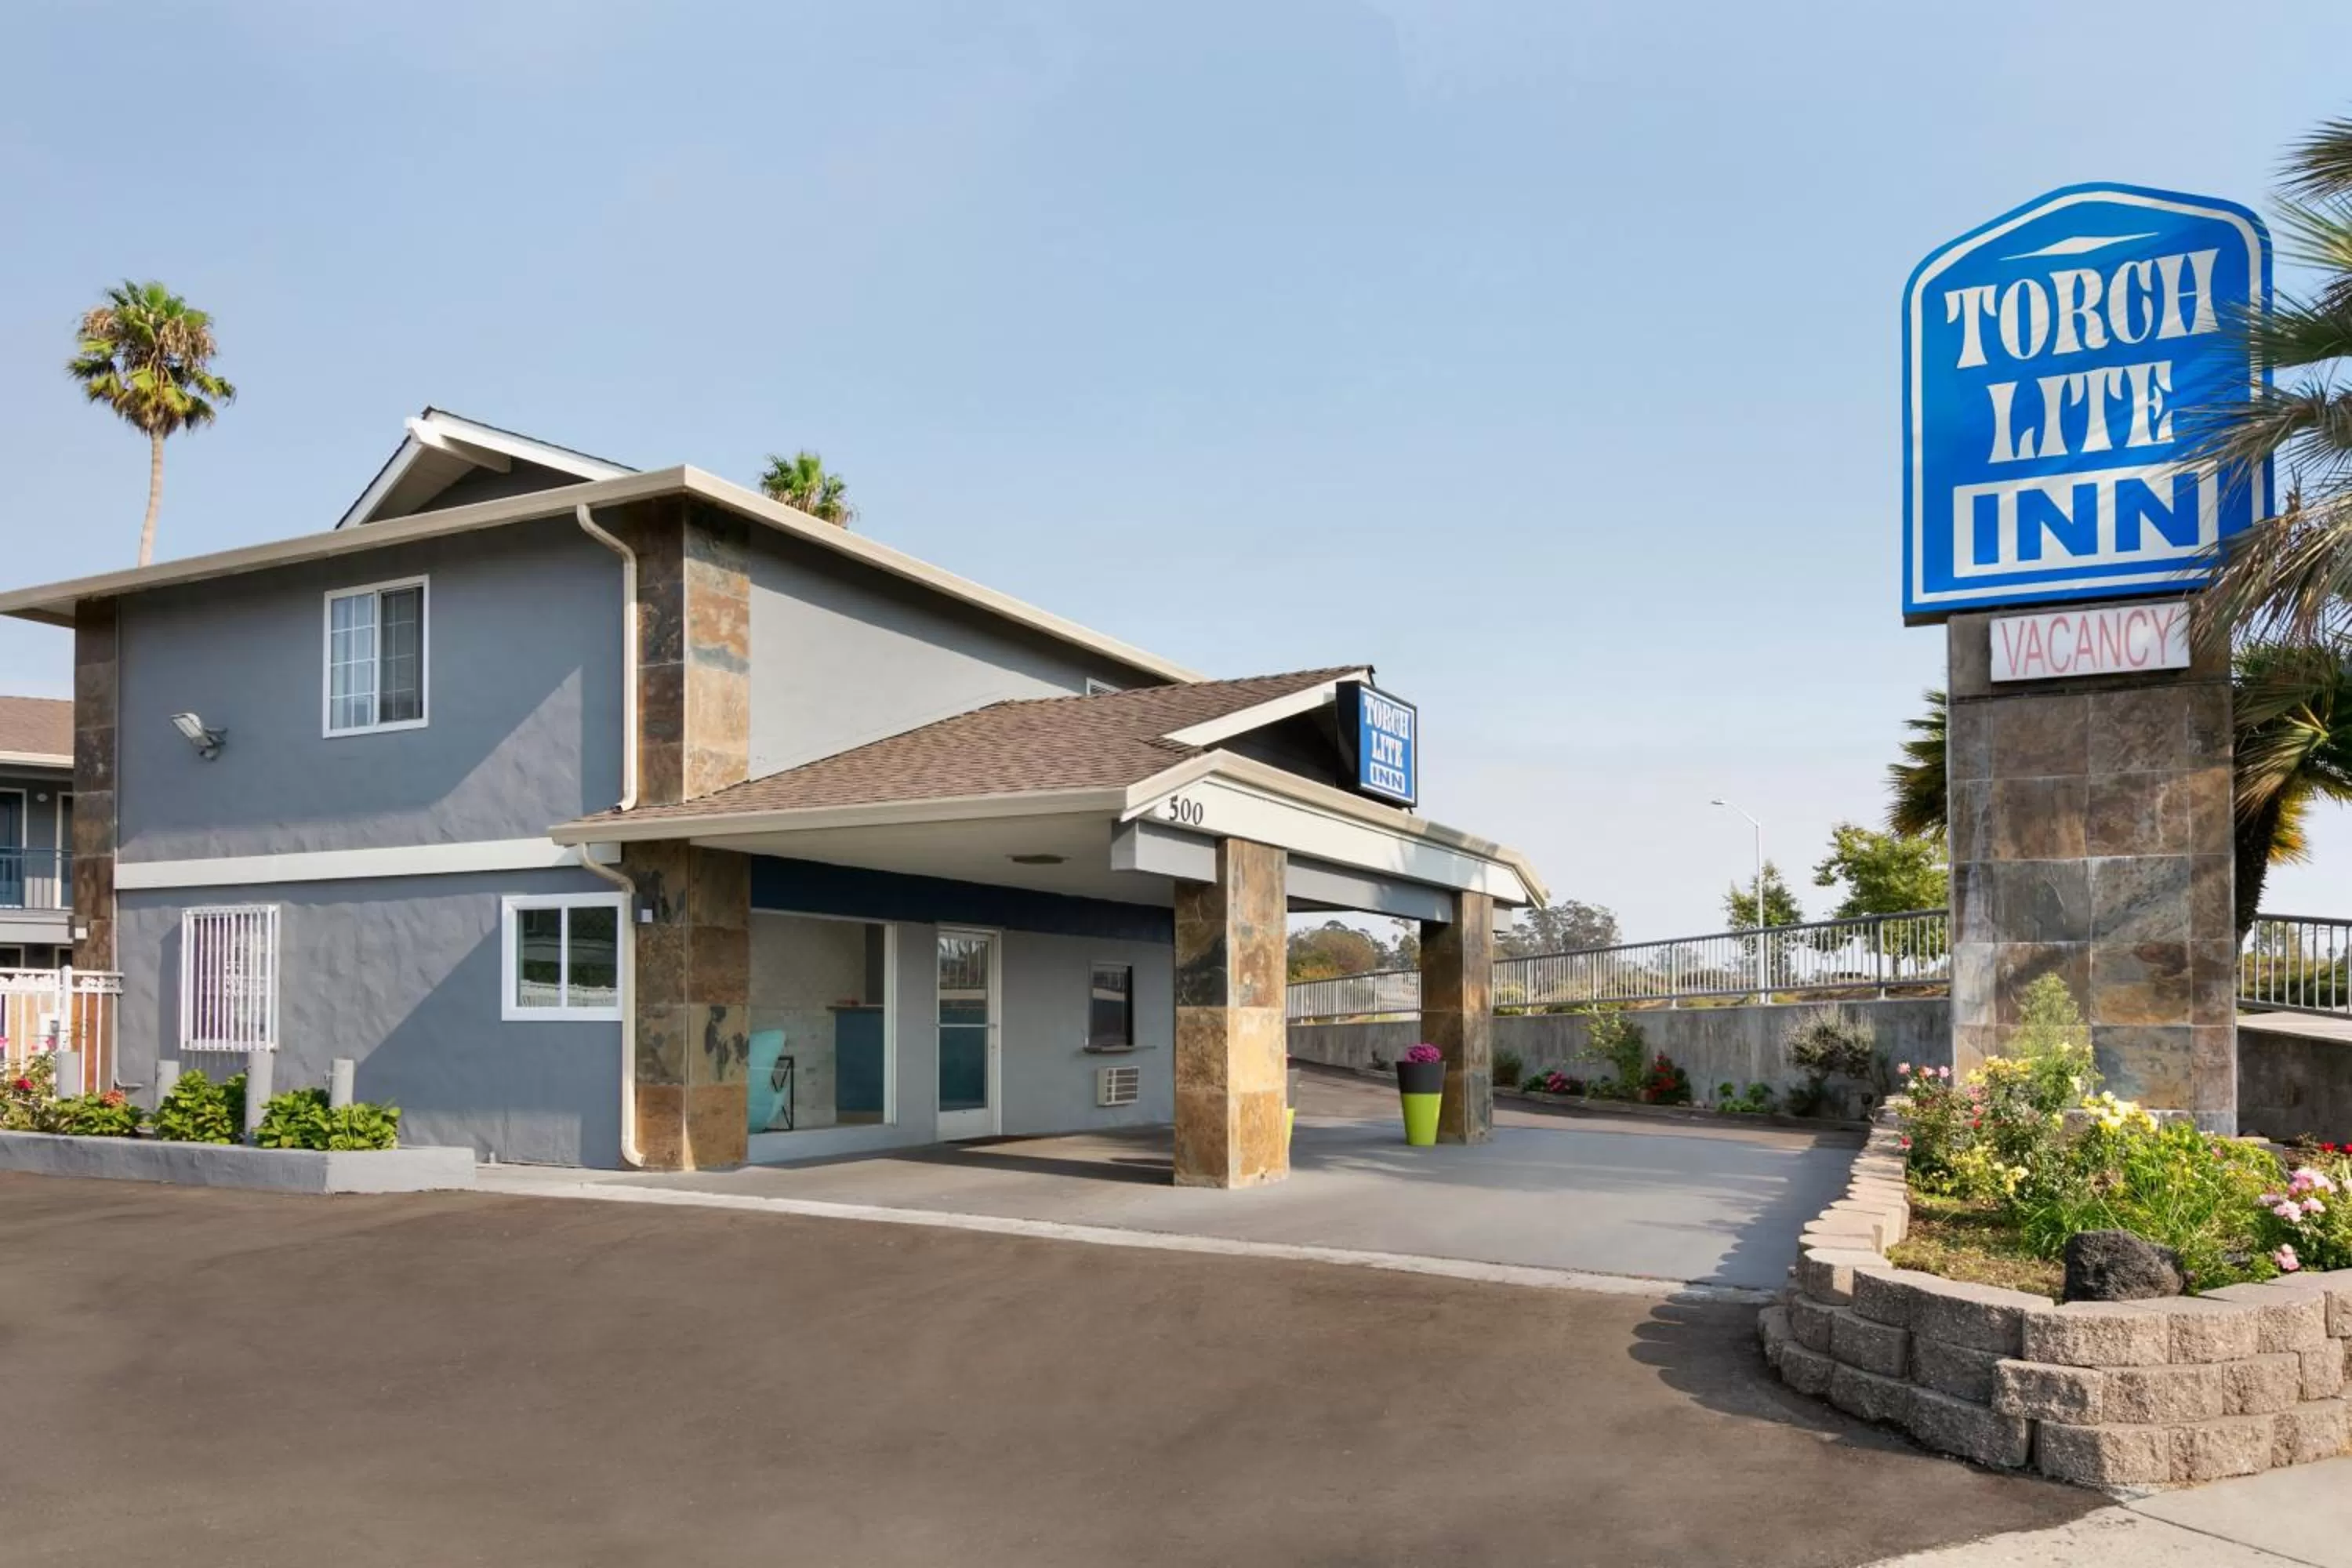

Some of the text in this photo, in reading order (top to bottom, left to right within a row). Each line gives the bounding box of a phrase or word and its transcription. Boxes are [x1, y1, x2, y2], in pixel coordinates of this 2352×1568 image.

[1945, 248, 2221, 368] TORCH
[1987, 360, 2175, 463] LITE
[1973, 472, 2199, 565] INN
[2002, 608, 2176, 676] VACANCY
[1364, 695, 1410, 739] TORCH
[1372, 731, 1403, 769] LITE
[1373, 765, 1403, 792] INN
[1170, 795, 1203, 825] 500
